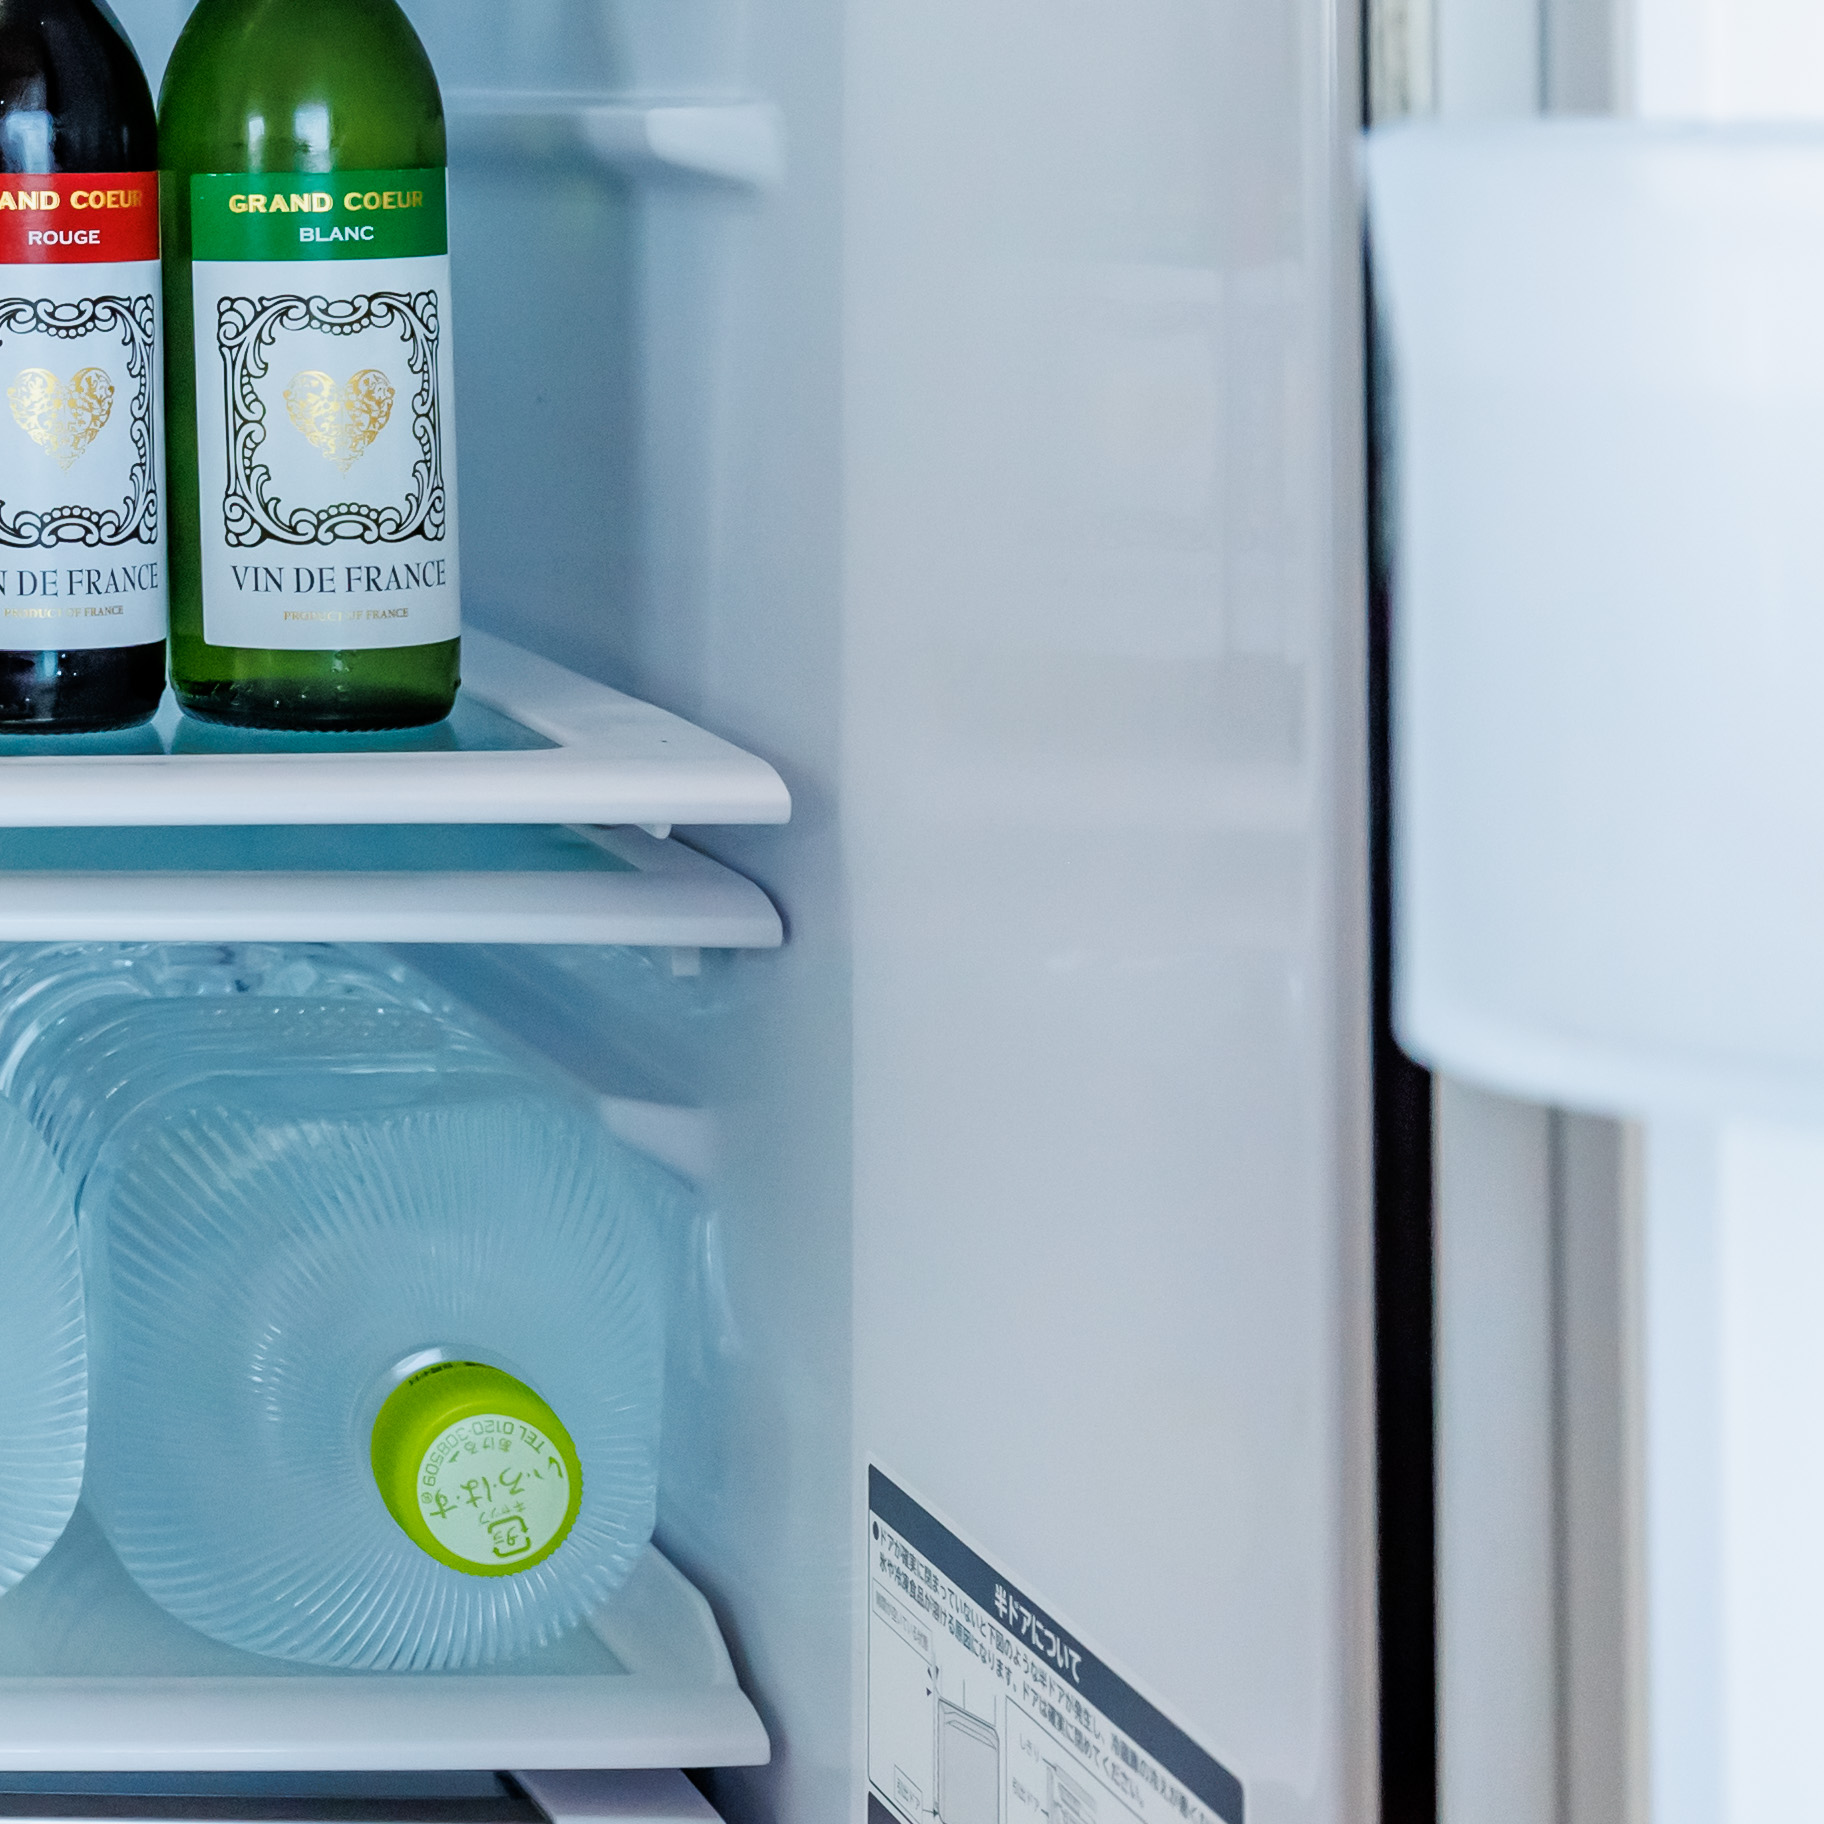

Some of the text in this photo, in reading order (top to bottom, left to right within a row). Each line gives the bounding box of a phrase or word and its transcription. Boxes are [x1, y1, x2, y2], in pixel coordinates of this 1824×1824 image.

[69, 189, 143, 210] COEUR
[228, 190, 424, 213] GRAND COEUR
[28, 230, 101, 246] ROUGE
[299, 225, 375, 243] BLANC
[16, 570, 60, 598] DE
[67, 562, 159, 595] FRANCE
[231, 559, 446, 593] VIN DE FRANCE
[85, 605, 124, 618] FRANCE
[367, 607, 409, 620] FRANCE
[423, 1420, 546, 1487] TEL 0120-308509
[994, 1583, 1082, 1683] 半ドアについて
